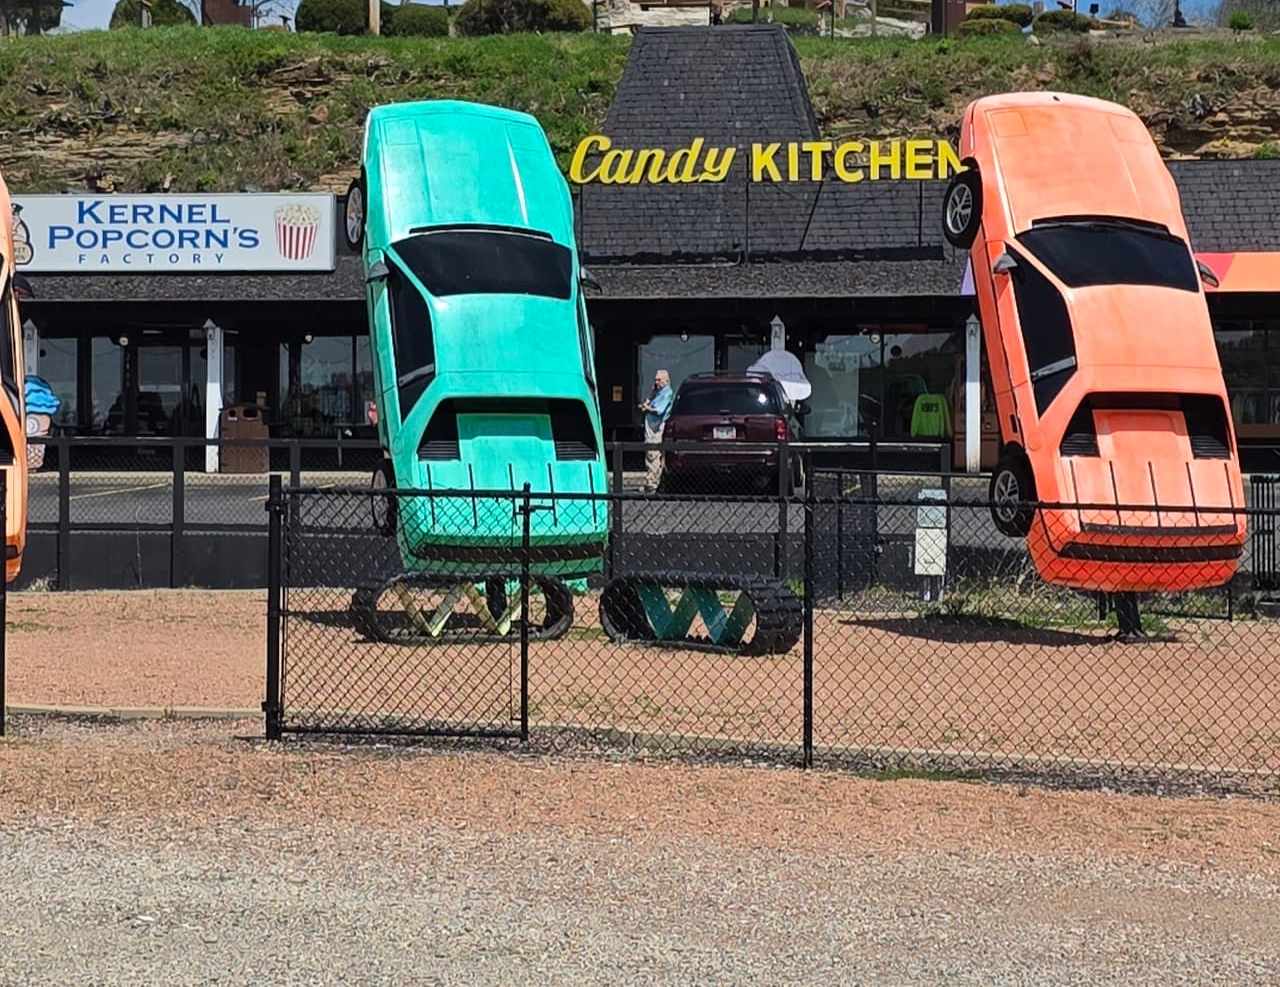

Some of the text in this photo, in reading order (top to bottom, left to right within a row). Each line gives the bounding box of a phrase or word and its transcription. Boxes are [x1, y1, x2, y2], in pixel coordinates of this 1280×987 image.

[569, 134, 969, 185] Candy KITCHEN
[77, 200, 231, 225] KERNEL
[47, 224, 260, 249] POPCORN'S
[78, 253, 225, 265] FACTORY
